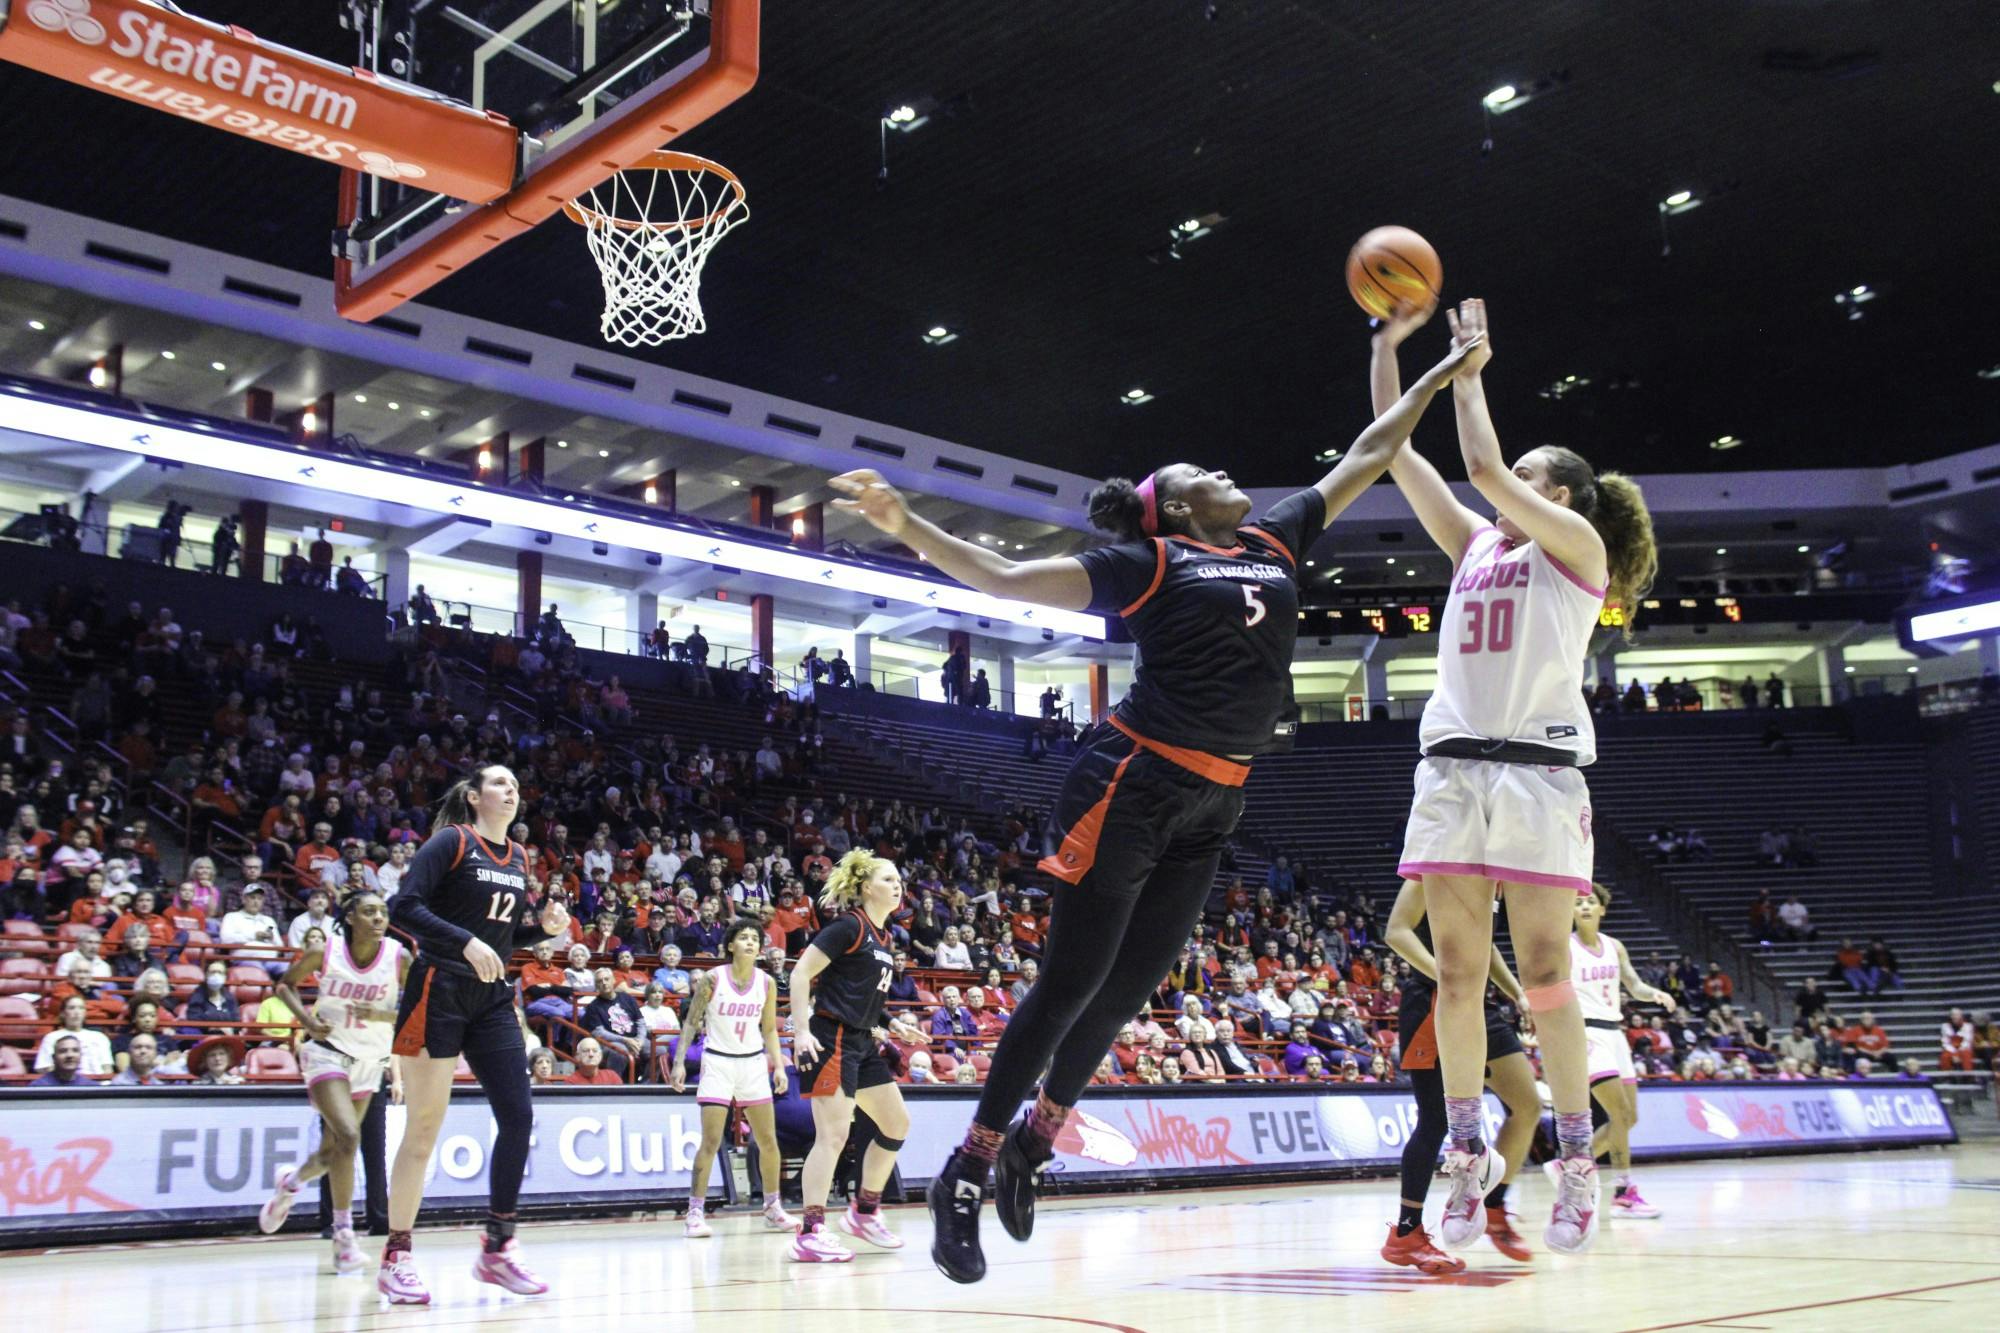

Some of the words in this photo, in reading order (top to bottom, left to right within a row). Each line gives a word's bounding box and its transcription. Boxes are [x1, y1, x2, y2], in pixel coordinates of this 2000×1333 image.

[1241, 584, 1267, 628] 5
[1371, 617, 1385, 632] 4
[1408, 614, 1431, 632] 72
[1459, 598, 1515, 654] 30
[476, 867, 491, 881] SAN
[486, 891, 516, 923] 12
[327, 980, 389, 1002] LOBOS
[876, 966, 893, 993] 24
[718, 1002, 762, 1018] LOBOS
[734, 1021, 747, 1043] 4
[1792, 1100, 1842, 1133] FUE
[1894, 1095, 1944, 1127] Club
[156, 1126, 321, 1195] FUE
[559, 1114, 702, 1176] Club
